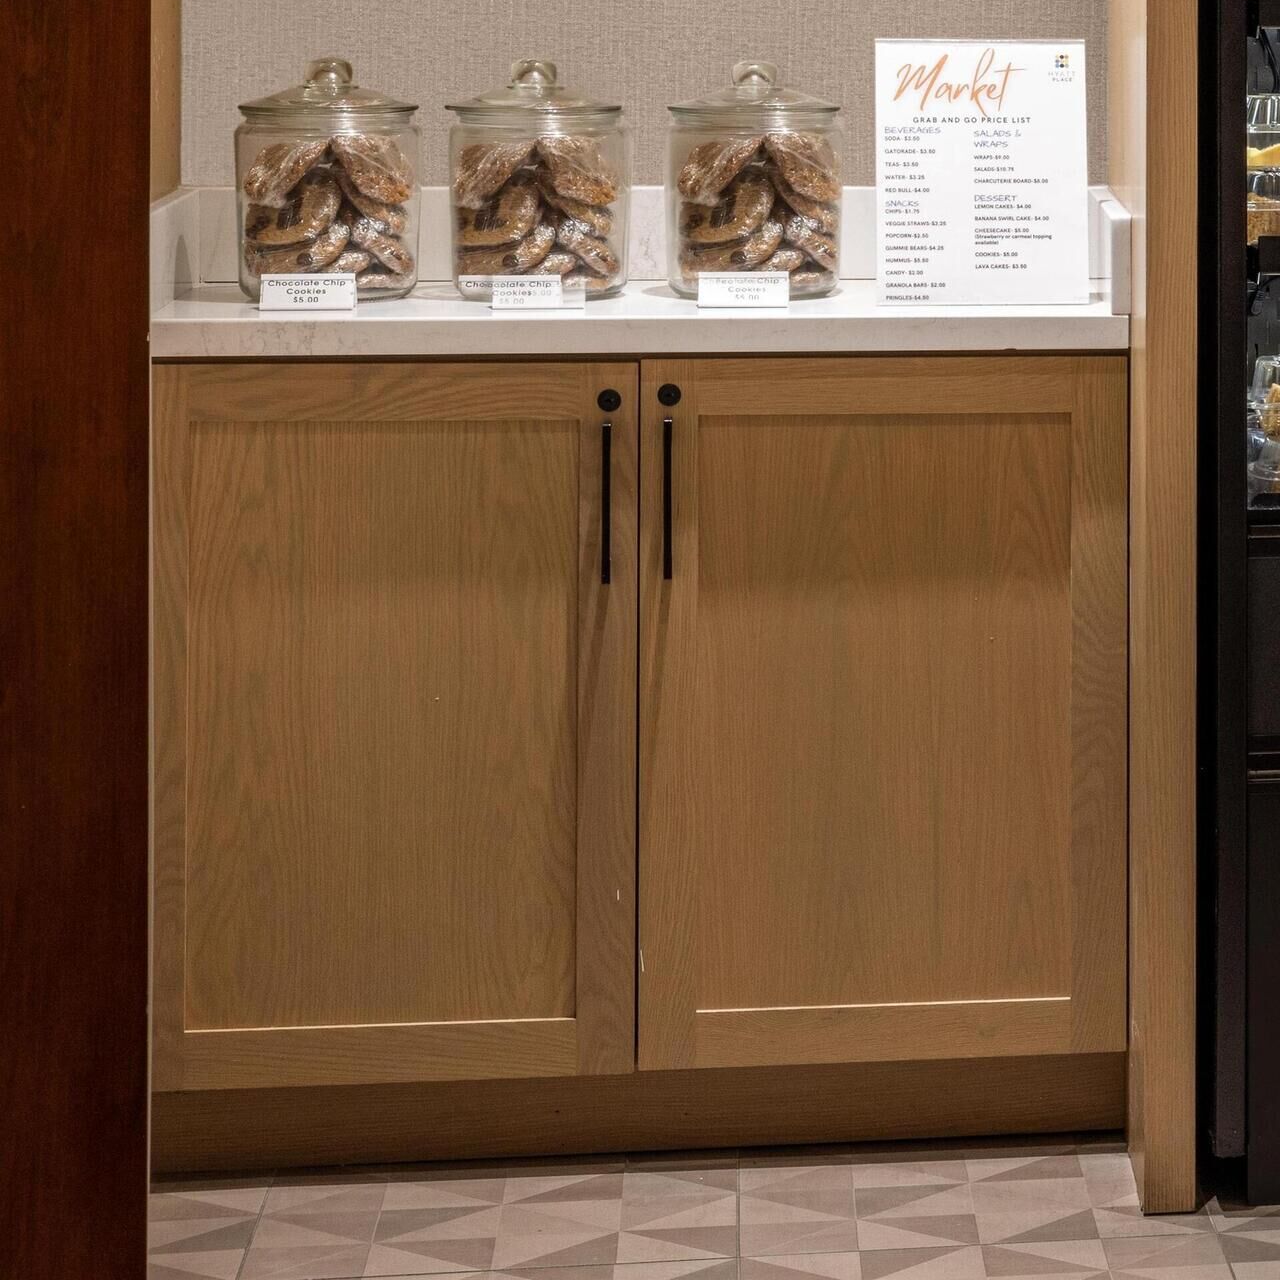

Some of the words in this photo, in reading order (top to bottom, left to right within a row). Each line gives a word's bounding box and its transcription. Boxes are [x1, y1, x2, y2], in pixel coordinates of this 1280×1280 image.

[893, 48, 1027, 117] Market
[884, 126, 941, 134] BEVERAGES
[973, 129, 1011, 138] SALADS
[973, 140, 1008, 148] WRAPS
[974, 194, 1017, 202] DESSERT
[267, 279, 320, 287] Chocolate
[323, 279, 346, 287] Chip
